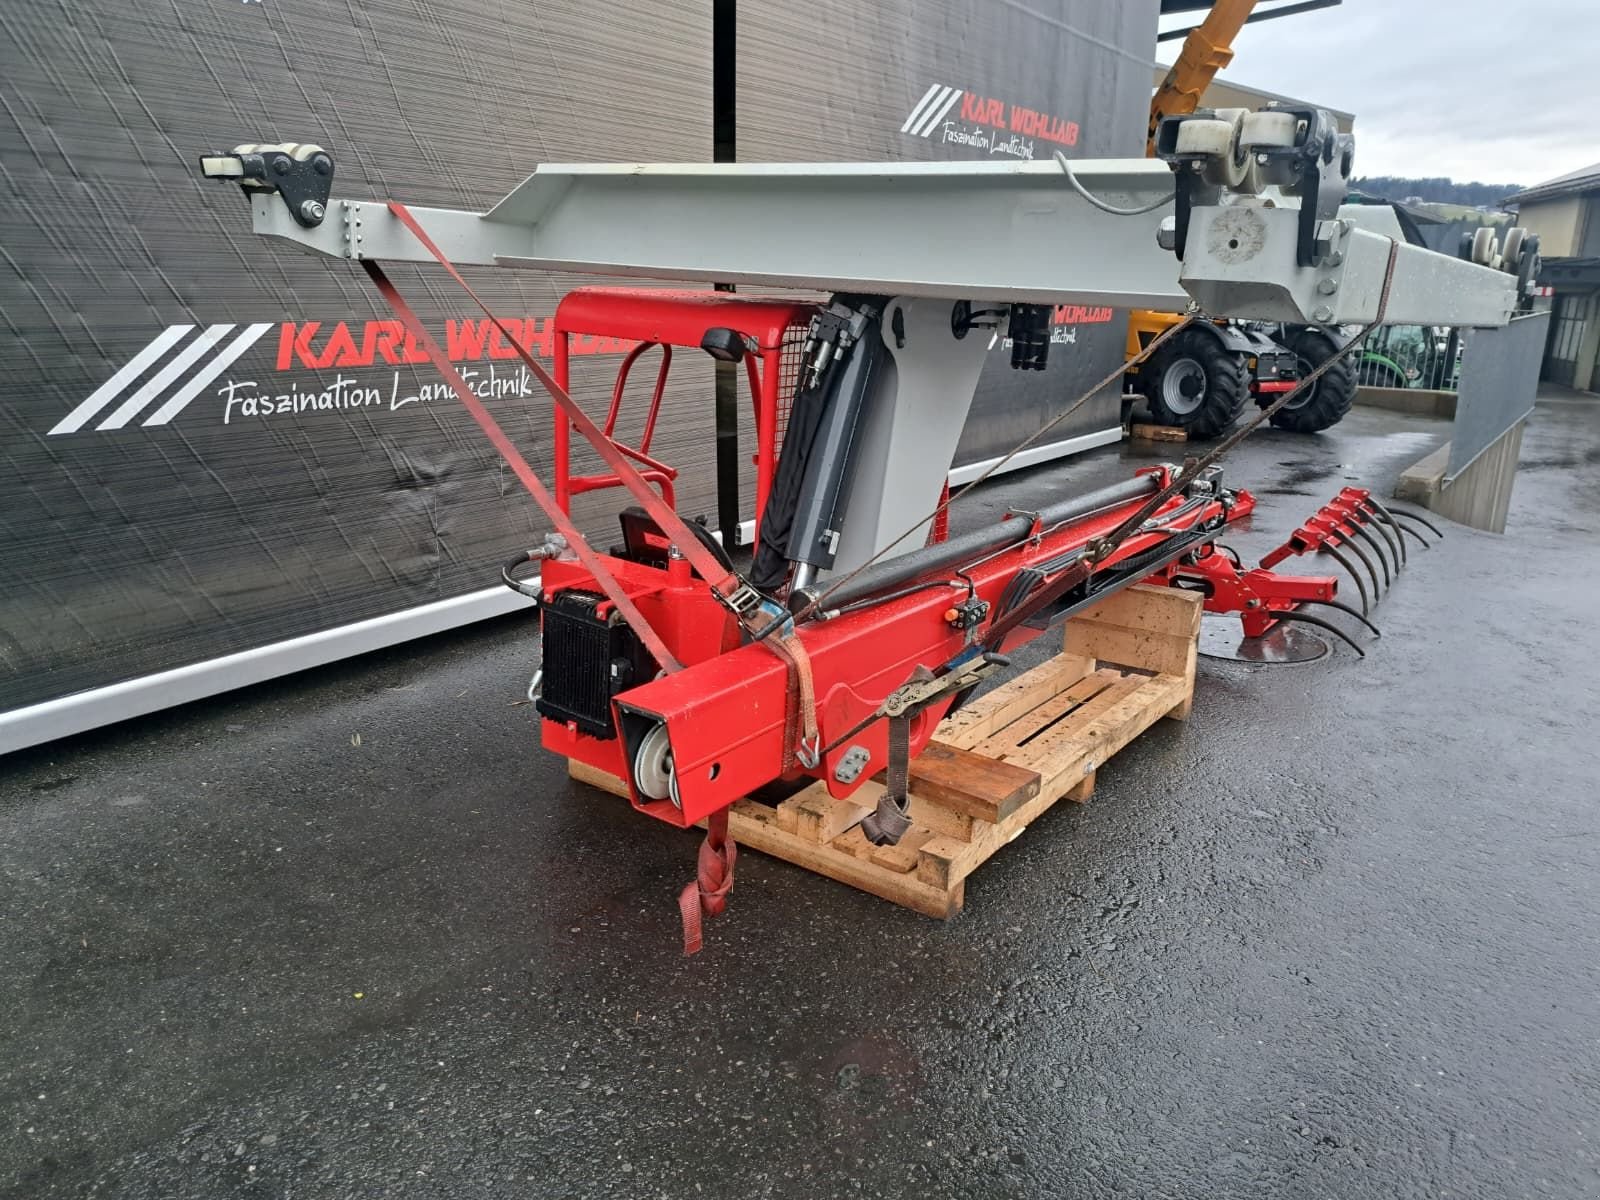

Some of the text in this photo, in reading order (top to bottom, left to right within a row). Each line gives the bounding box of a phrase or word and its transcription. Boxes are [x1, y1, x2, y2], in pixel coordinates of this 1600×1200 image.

[960, 92, 1006, 128] KARL
[943, 119, 1034, 160] Faszination Landtechnik
[276, 320, 434, 371] KARL
[218, 373, 381, 425] Faszination
